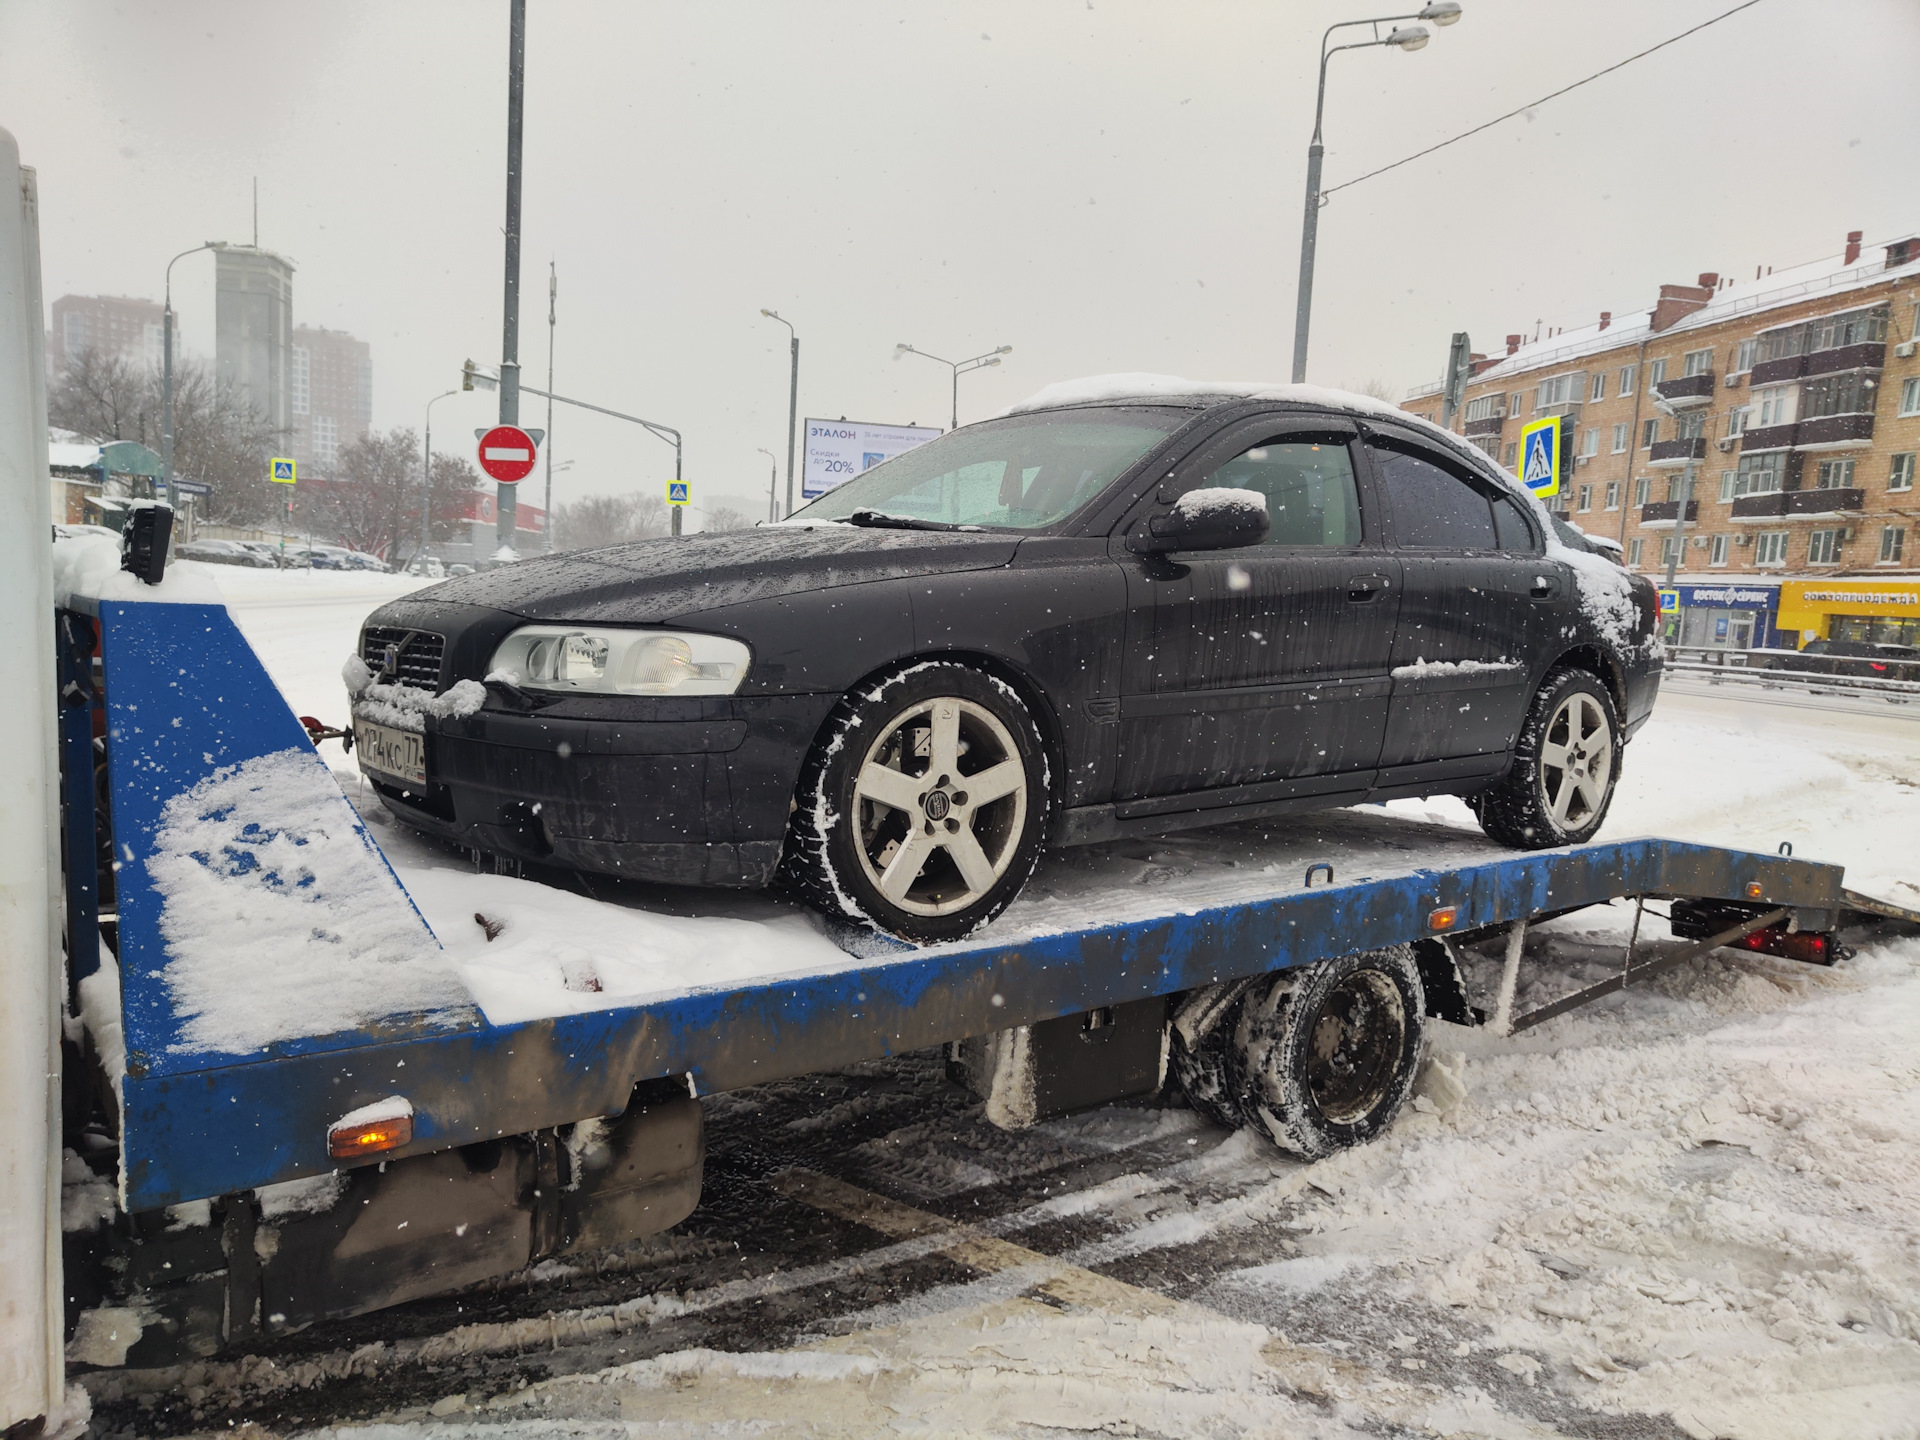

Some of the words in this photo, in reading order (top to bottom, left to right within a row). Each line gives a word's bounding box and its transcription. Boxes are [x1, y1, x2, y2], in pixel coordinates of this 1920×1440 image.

[811, 427, 856, 440] ЭТАЛОН
[810, 448, 840, 458] Скидки
[824, 459, 855, 474] 20%
[1693, 589, 1726, 602] ВОСТОК
[404, 735, 419, 766] 77
